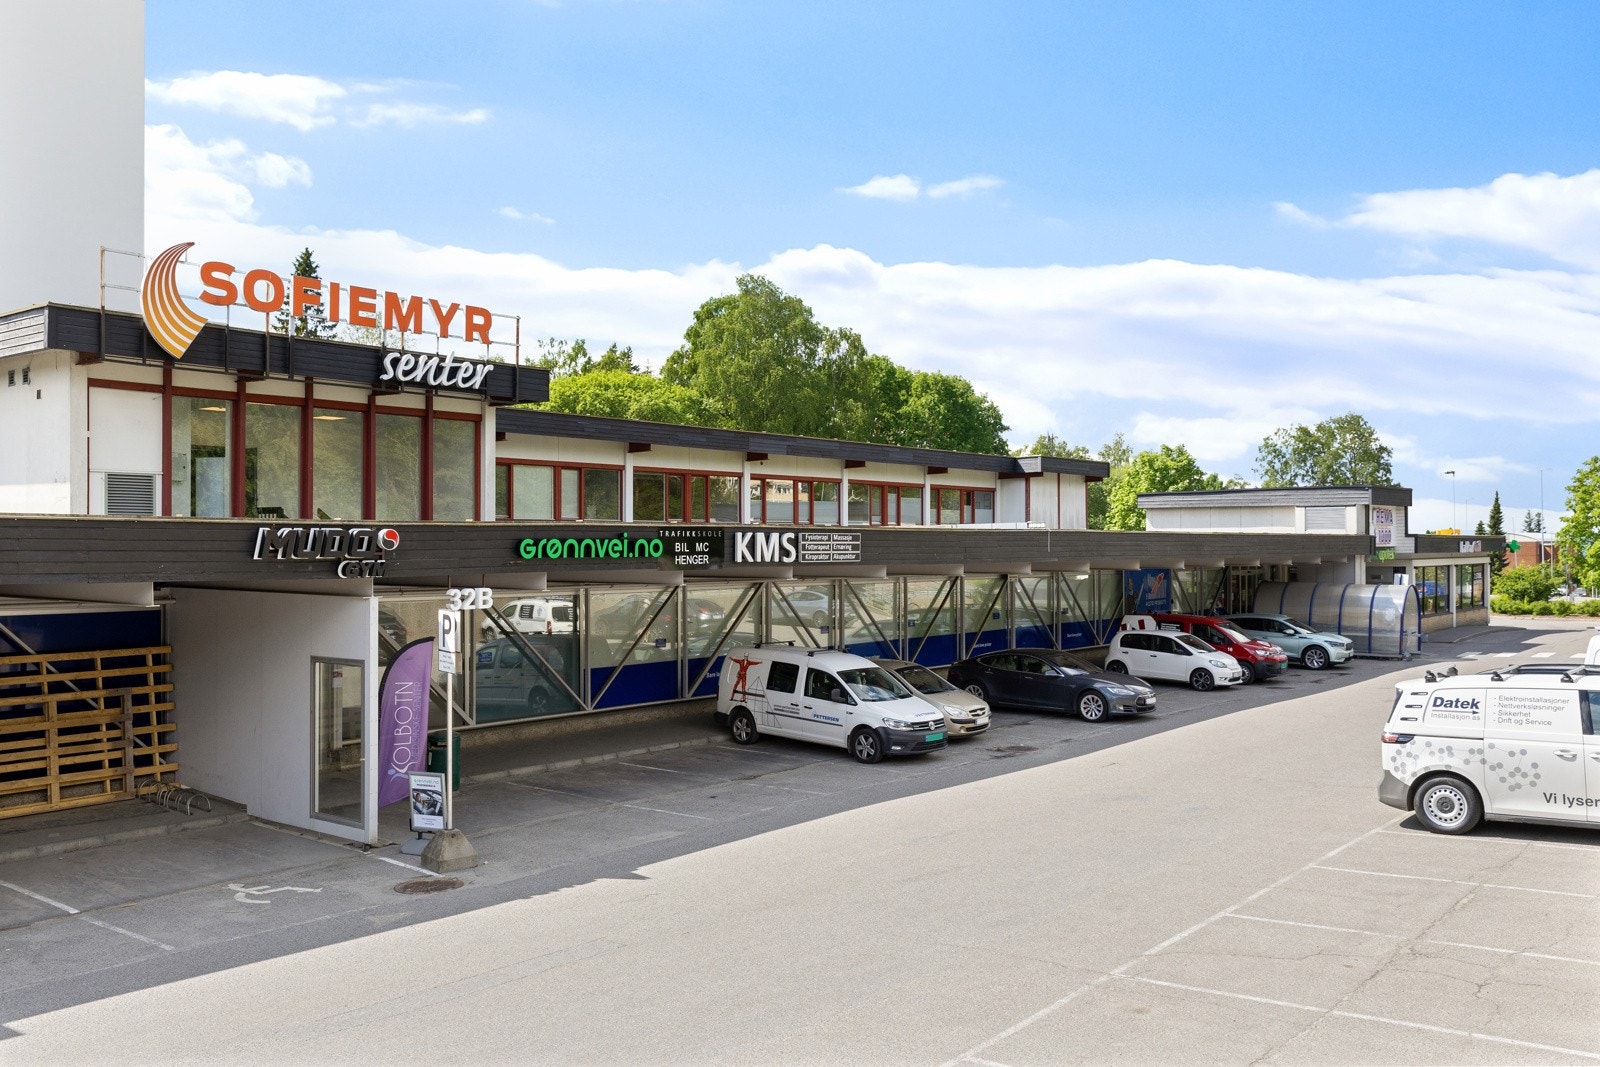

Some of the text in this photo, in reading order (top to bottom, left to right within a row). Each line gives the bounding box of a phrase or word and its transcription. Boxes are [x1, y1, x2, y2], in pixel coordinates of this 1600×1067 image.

[199, 261, 493, 344] SOFIEMYR
[380, 351, 494, 390] senter
[253, 527, 380, 560] MUDO
[675, 542, 709, 552] BIL MC
[734, 532, 798, 563] KMS
[675, 555, 709, 565] HENGER
[337, 560, 388, 578] GYM
[446, 587, 493, 611] 32B
[442, 614, 452, 648] P
[1432, 696, 1480, 710] Datek
[1498, 695, 1570, 704] Elektroinstallasjoner
[1498, 703, 1565, 712] Nettverksløsninger
[813, 714, 840, 722] PETTERSEN
[1431, 713, 1470, 721] Installasjon
[1525, 718, 1552, 726] Service
[391, 681, 418, 773] KOLBOTN
[1543, 792, 1600, 808] Vi lyser
